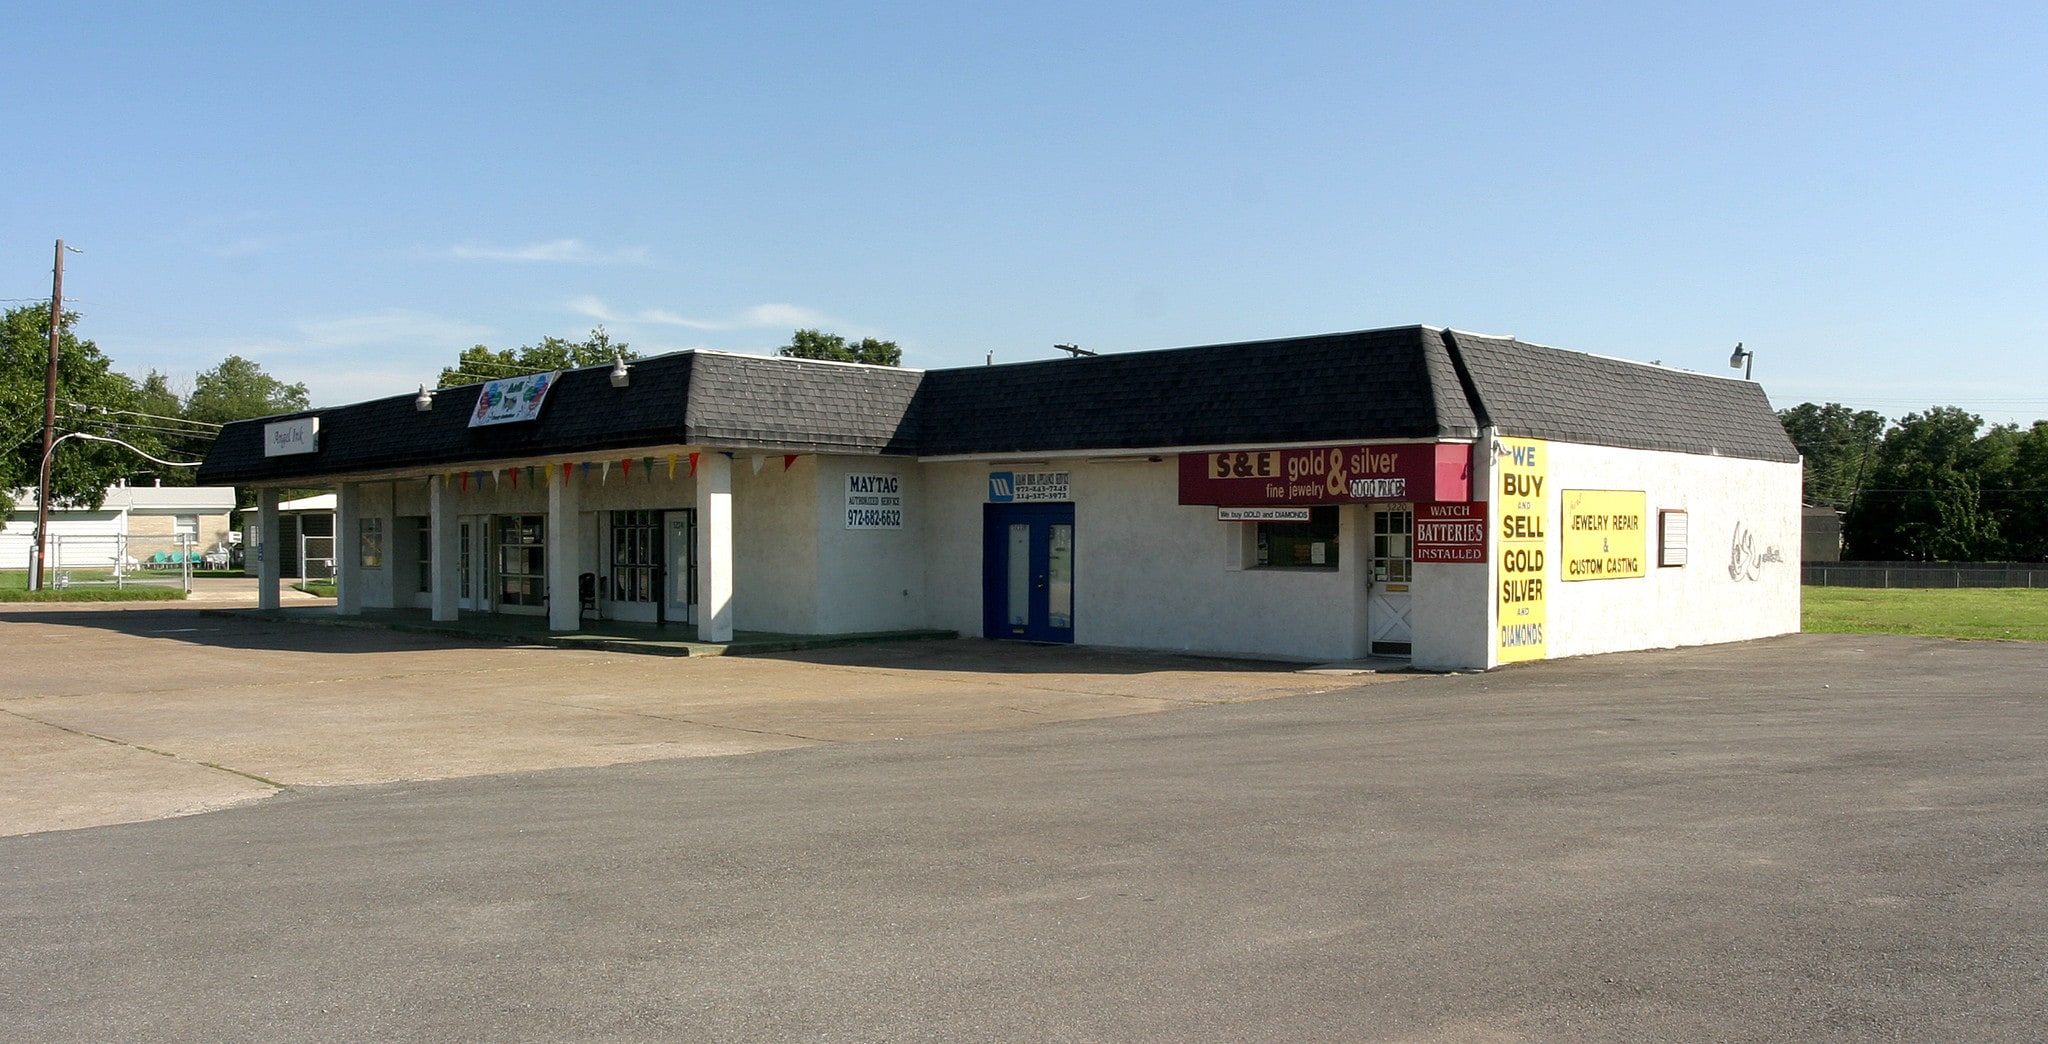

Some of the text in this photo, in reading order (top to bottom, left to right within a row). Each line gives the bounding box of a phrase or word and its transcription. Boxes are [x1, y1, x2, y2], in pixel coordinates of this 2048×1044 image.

[1512, 445, 1536, 467] WE
[1216, 448, 1398, 496] S&E gold & silver
[850, 476, 898, 493] MAYTAG
[1266, 481, 1325, 500] fine jewelry
[1350, 479, 1376, 497] GOOD
[1503, 473, 1544, 497] BUY
[1430, 505, 1470, 516] WATCH
[1517, 501, 1531, 510] AND
[1231, 511, 1242, 519] buy
[1275, 511, 1308, 519] DIAMONDS
[1571, 515, 1639, 531] JEWELRY REPAIR
[1417, 523, 1483, 542] BATTERIES
[1503, 514, 1544, 538] SELL
[1418, 549, 1482, 559] INSTALLED
[1603, 537, 1609, 553] &
[1504, 549, 1544, 573] GOLD
[1569, 557, 1638, 575] CUSTOM CASTING
[1503, 578, 1543, 604] SILVER
[1501, 622, 1543, 648] DIAMONDS
